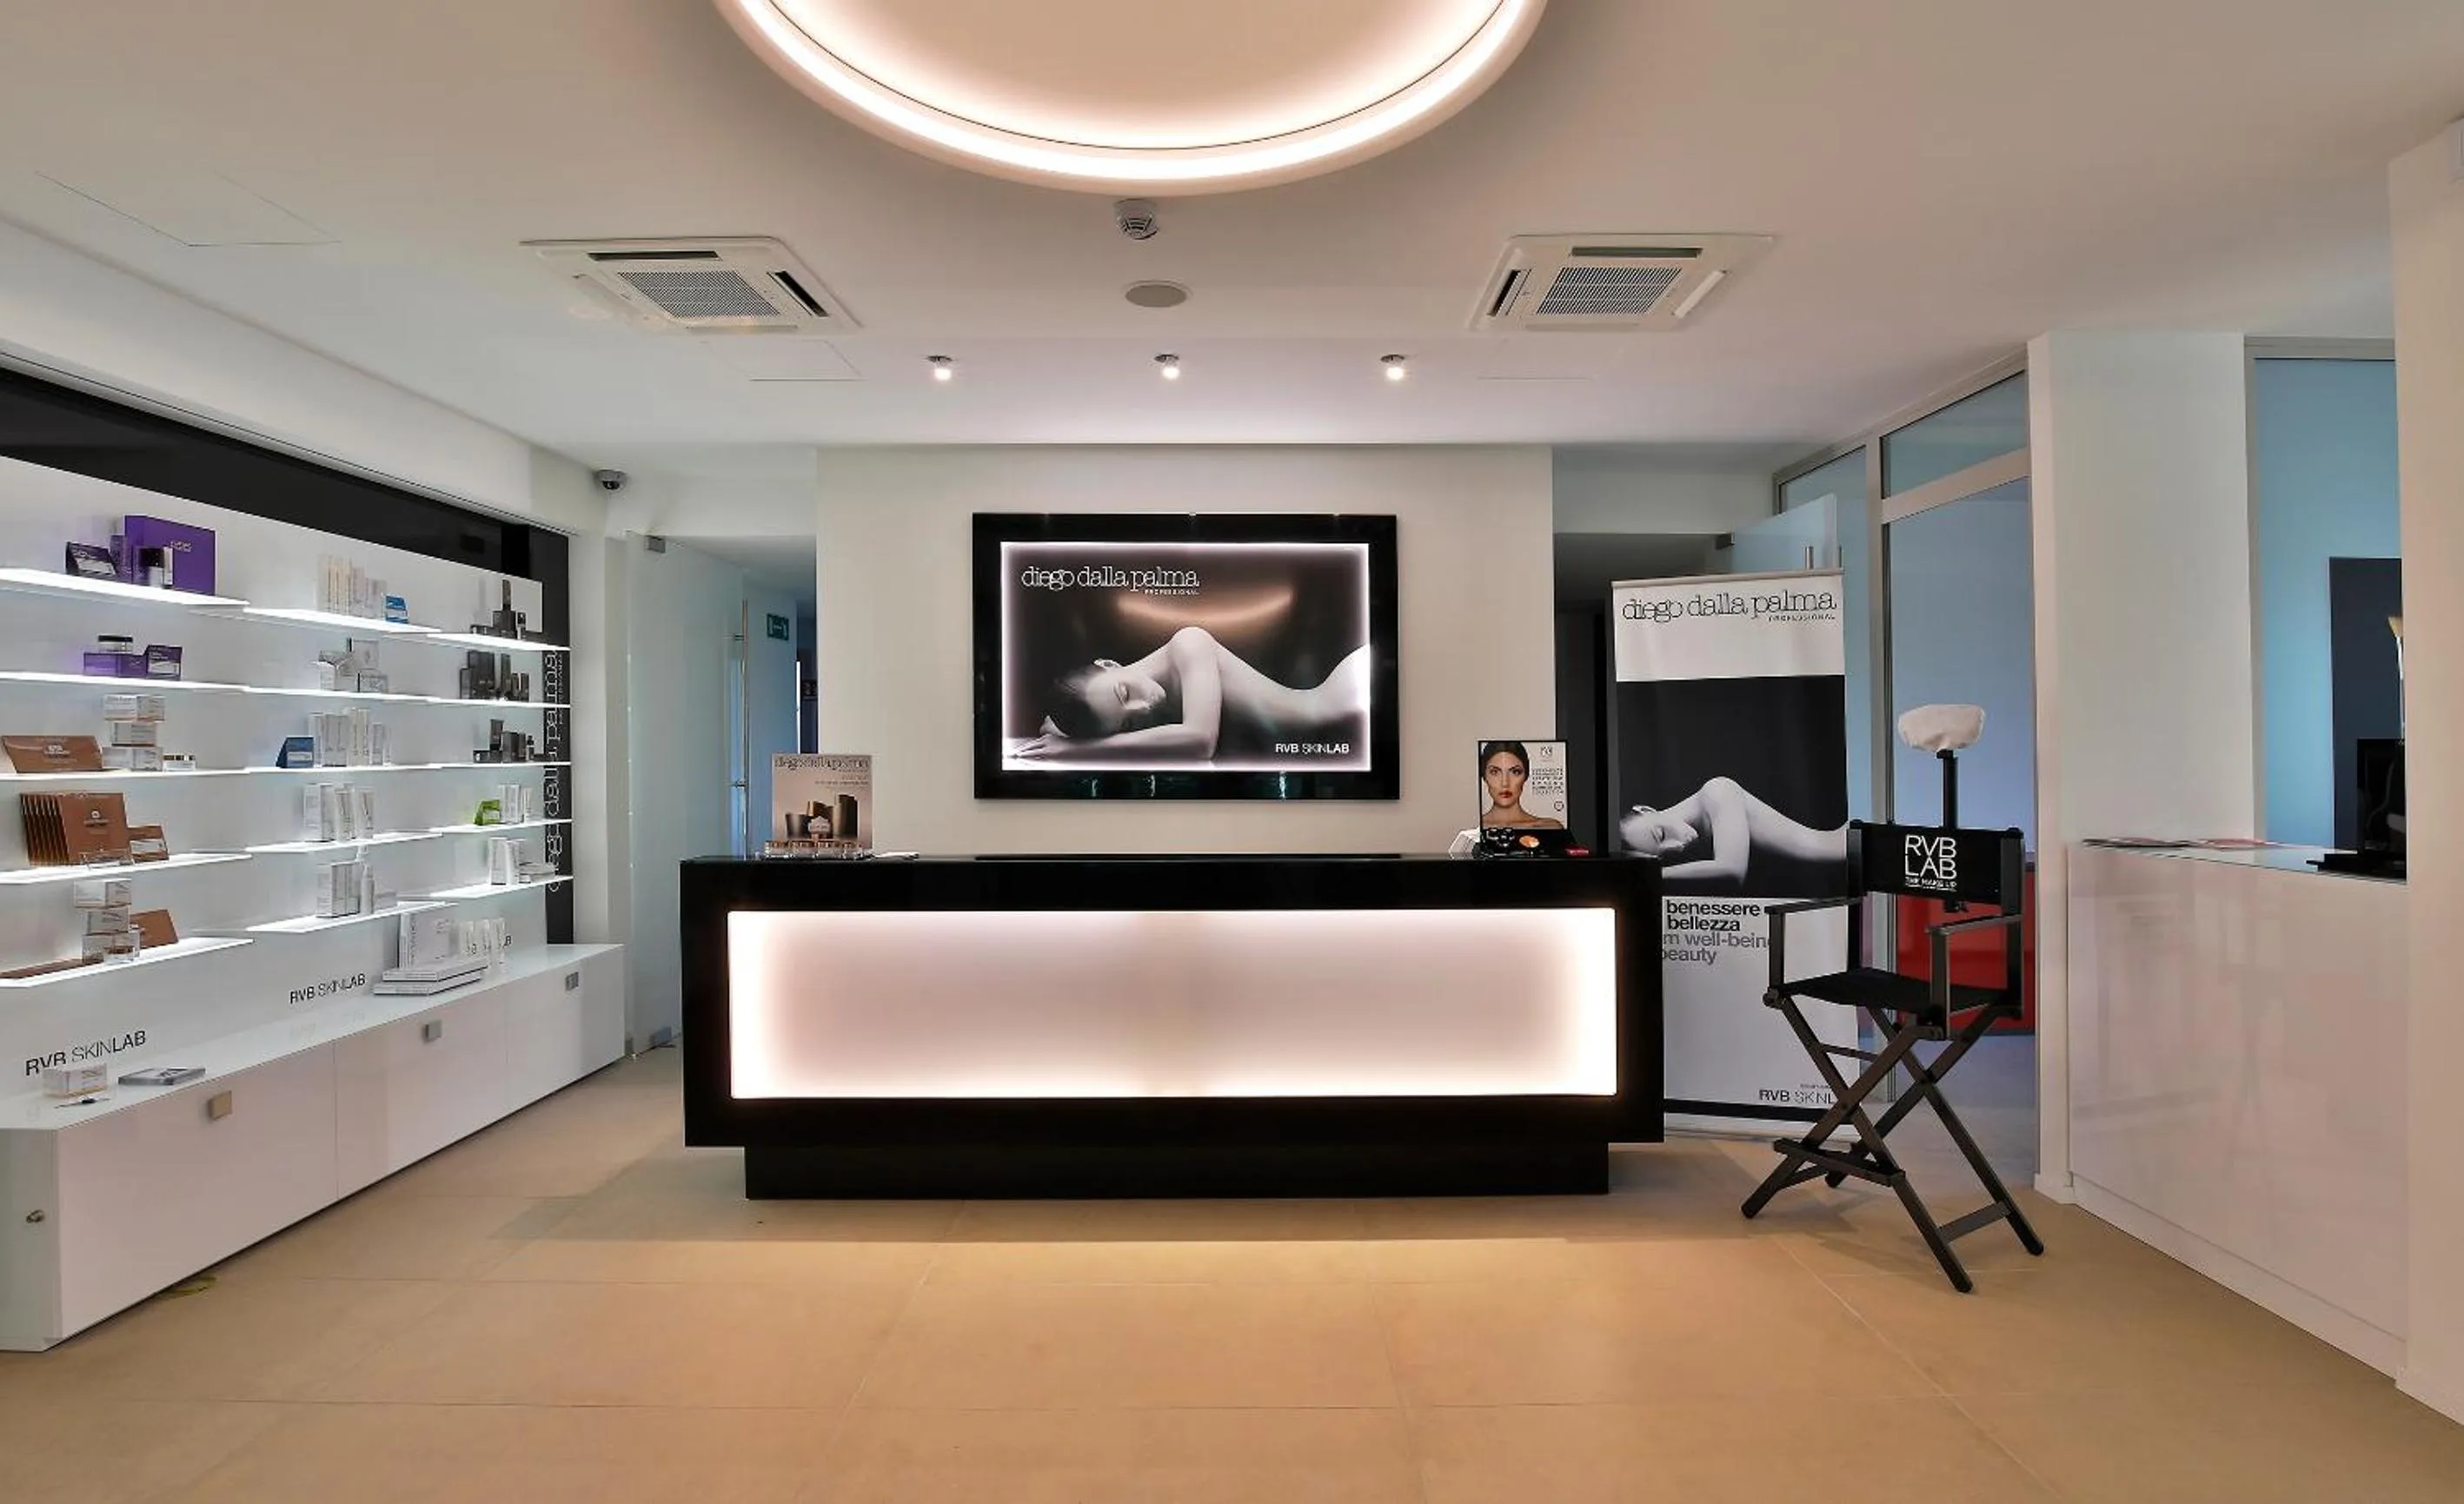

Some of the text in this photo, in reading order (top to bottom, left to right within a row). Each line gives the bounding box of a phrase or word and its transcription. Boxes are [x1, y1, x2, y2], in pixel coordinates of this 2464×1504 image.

[1021, 566, 1199, 592] diego dalla palma
[1622, 589, 1836, 623] diego dalla palma
[1275, 743, 1299, 753] RVB
[1905, 834, 1957, 858] RVB
[1905, 855, 1957, 879] LAB
[1666, 899, 1761, 917] benessere
[1667, 914, 1741, 931] bellezza
[1685, 932, 1770, 949] well-bein
[289, 986, 315, 1004] RVB
[25, 1030, 146, 1077] RVB SKINLAB
[1758, 1089, 1790, 1103] RVB
